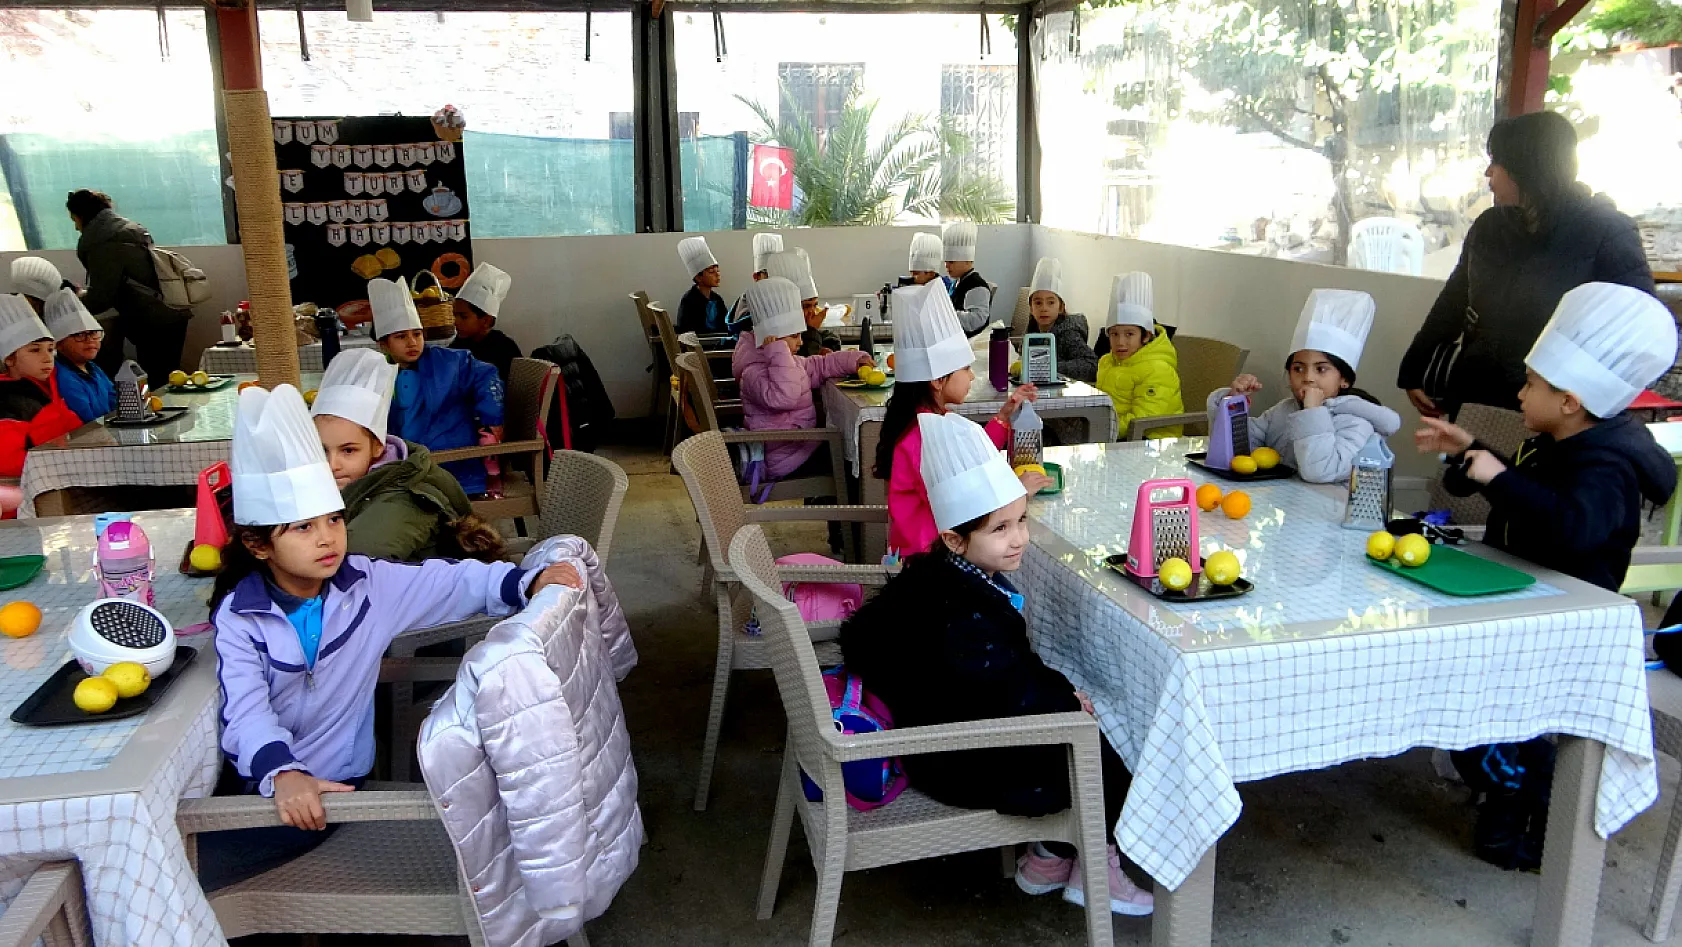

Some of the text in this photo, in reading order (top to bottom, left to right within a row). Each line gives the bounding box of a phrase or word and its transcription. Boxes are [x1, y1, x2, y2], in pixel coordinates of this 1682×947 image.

[277, 125, 334, 139] TUM
[317, 144, 451, 163] YATIRIM
[291, 203, 382, 219] LLARI
[331, 223, 460, 241] HAFTASI
